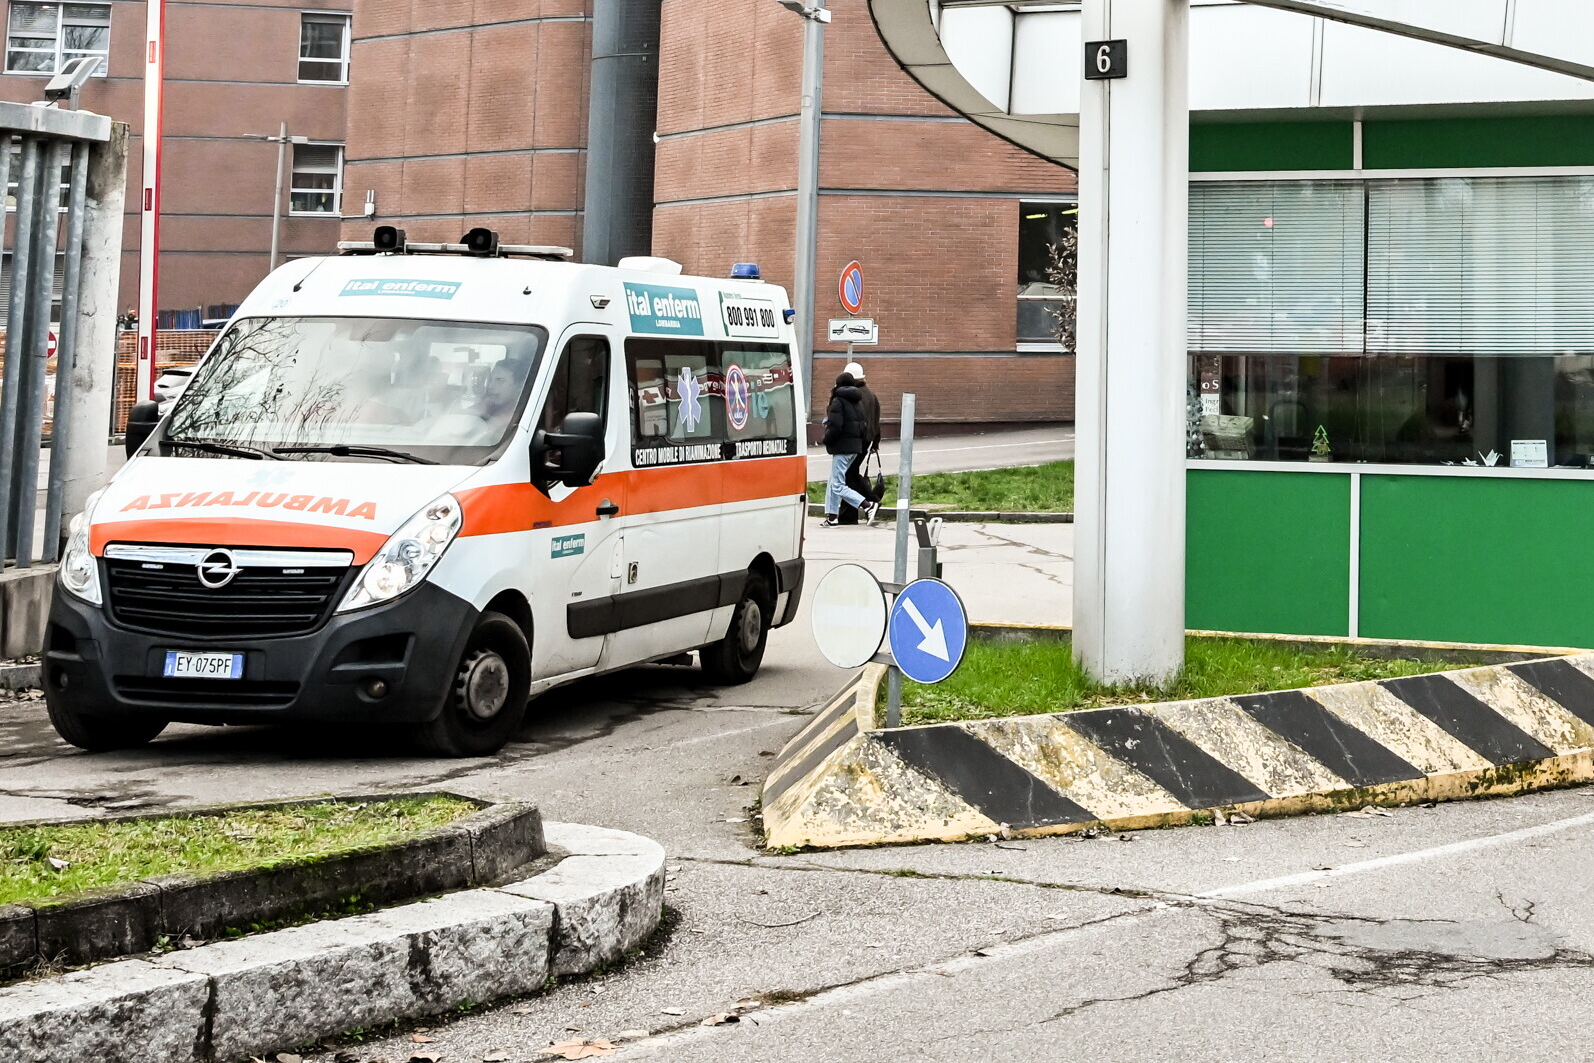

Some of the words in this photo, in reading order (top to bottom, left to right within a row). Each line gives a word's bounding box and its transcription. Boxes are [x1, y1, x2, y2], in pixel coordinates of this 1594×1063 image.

[1096, 45, 1111, 73] 6
[345, 280, 380, 291] ital
[382, 281, 457, 294] enferm
[627, 289, 651, 315] ital
[653, 292, 700, 319] enferm
[727, 306, 743, 326] 800
[744, 307, 759, 327] 991
[760, 308, 775, 328] 800
[635, 448, 657, 466] CENTRO
[658, 446, 678, 463] MOBILE
[679, 446, 685, 461] DI
[686, 443, 722, 461] RIANIMAZIONE
[735, 441, 762, 456] TRASPORTO
[763, 439, 787, 454] NEONATALE
[176, 656, 192, 672] EY
[195, 657, 232, 674] 075PF
